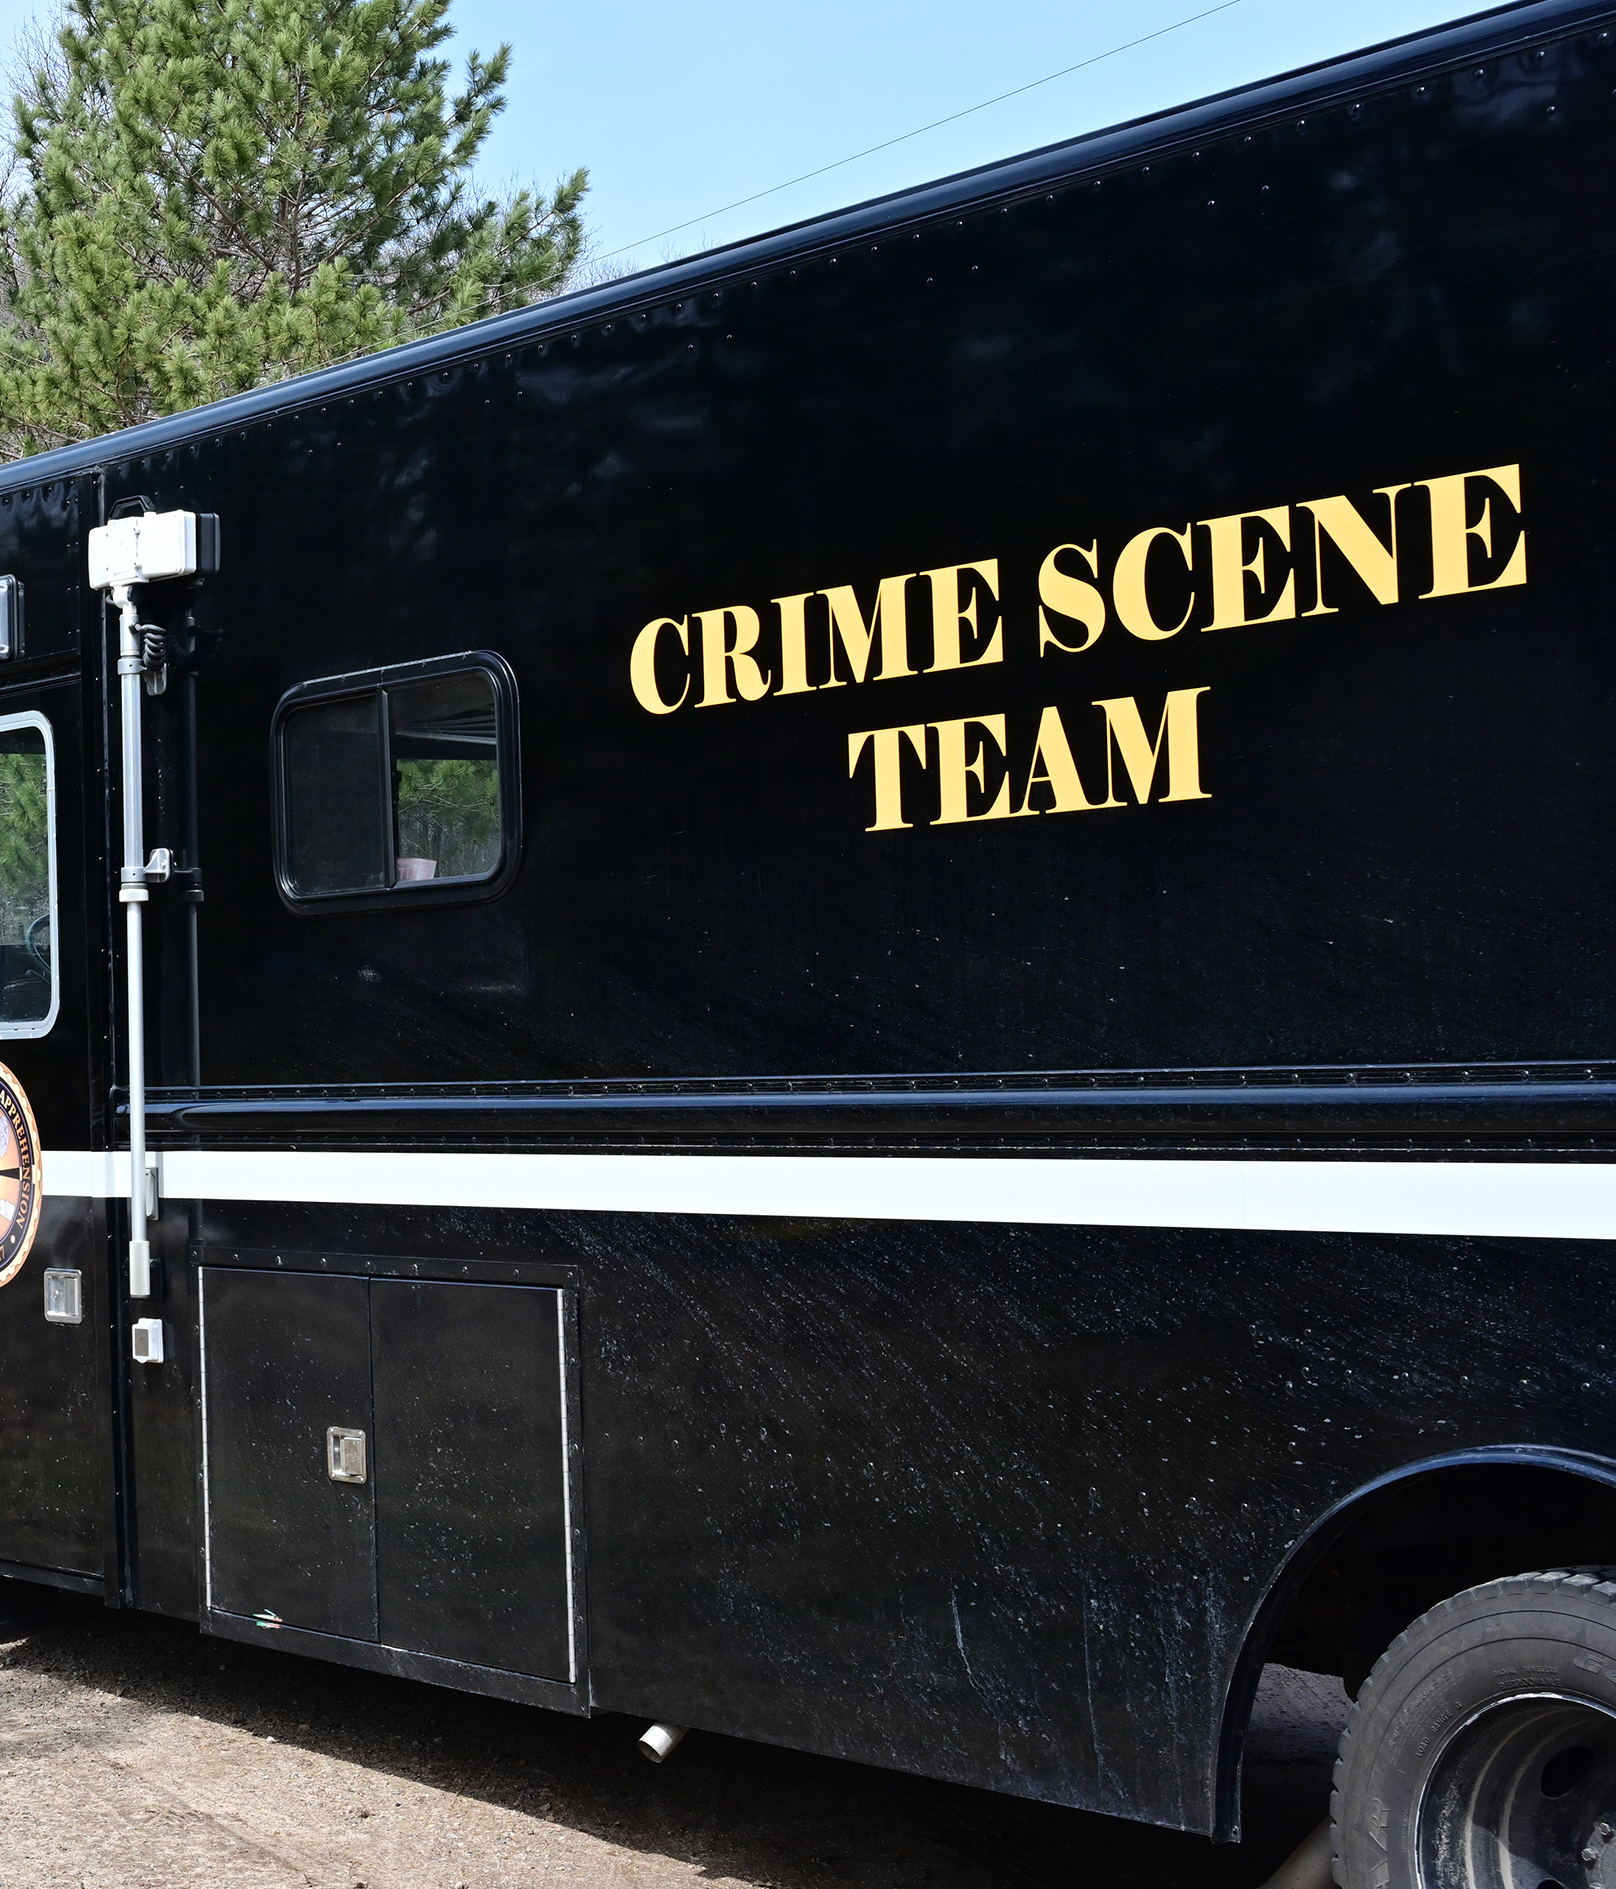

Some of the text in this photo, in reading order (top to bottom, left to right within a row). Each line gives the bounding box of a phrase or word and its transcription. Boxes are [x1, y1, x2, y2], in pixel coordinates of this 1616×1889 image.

[630, 464, 1527, 714] CRIME SCENE
[848, 687, 1212, 831] TEAM
[1415, 1736, 1430, 1758] LOAD
[1430, 1709, 1452, 1734] RANGE
